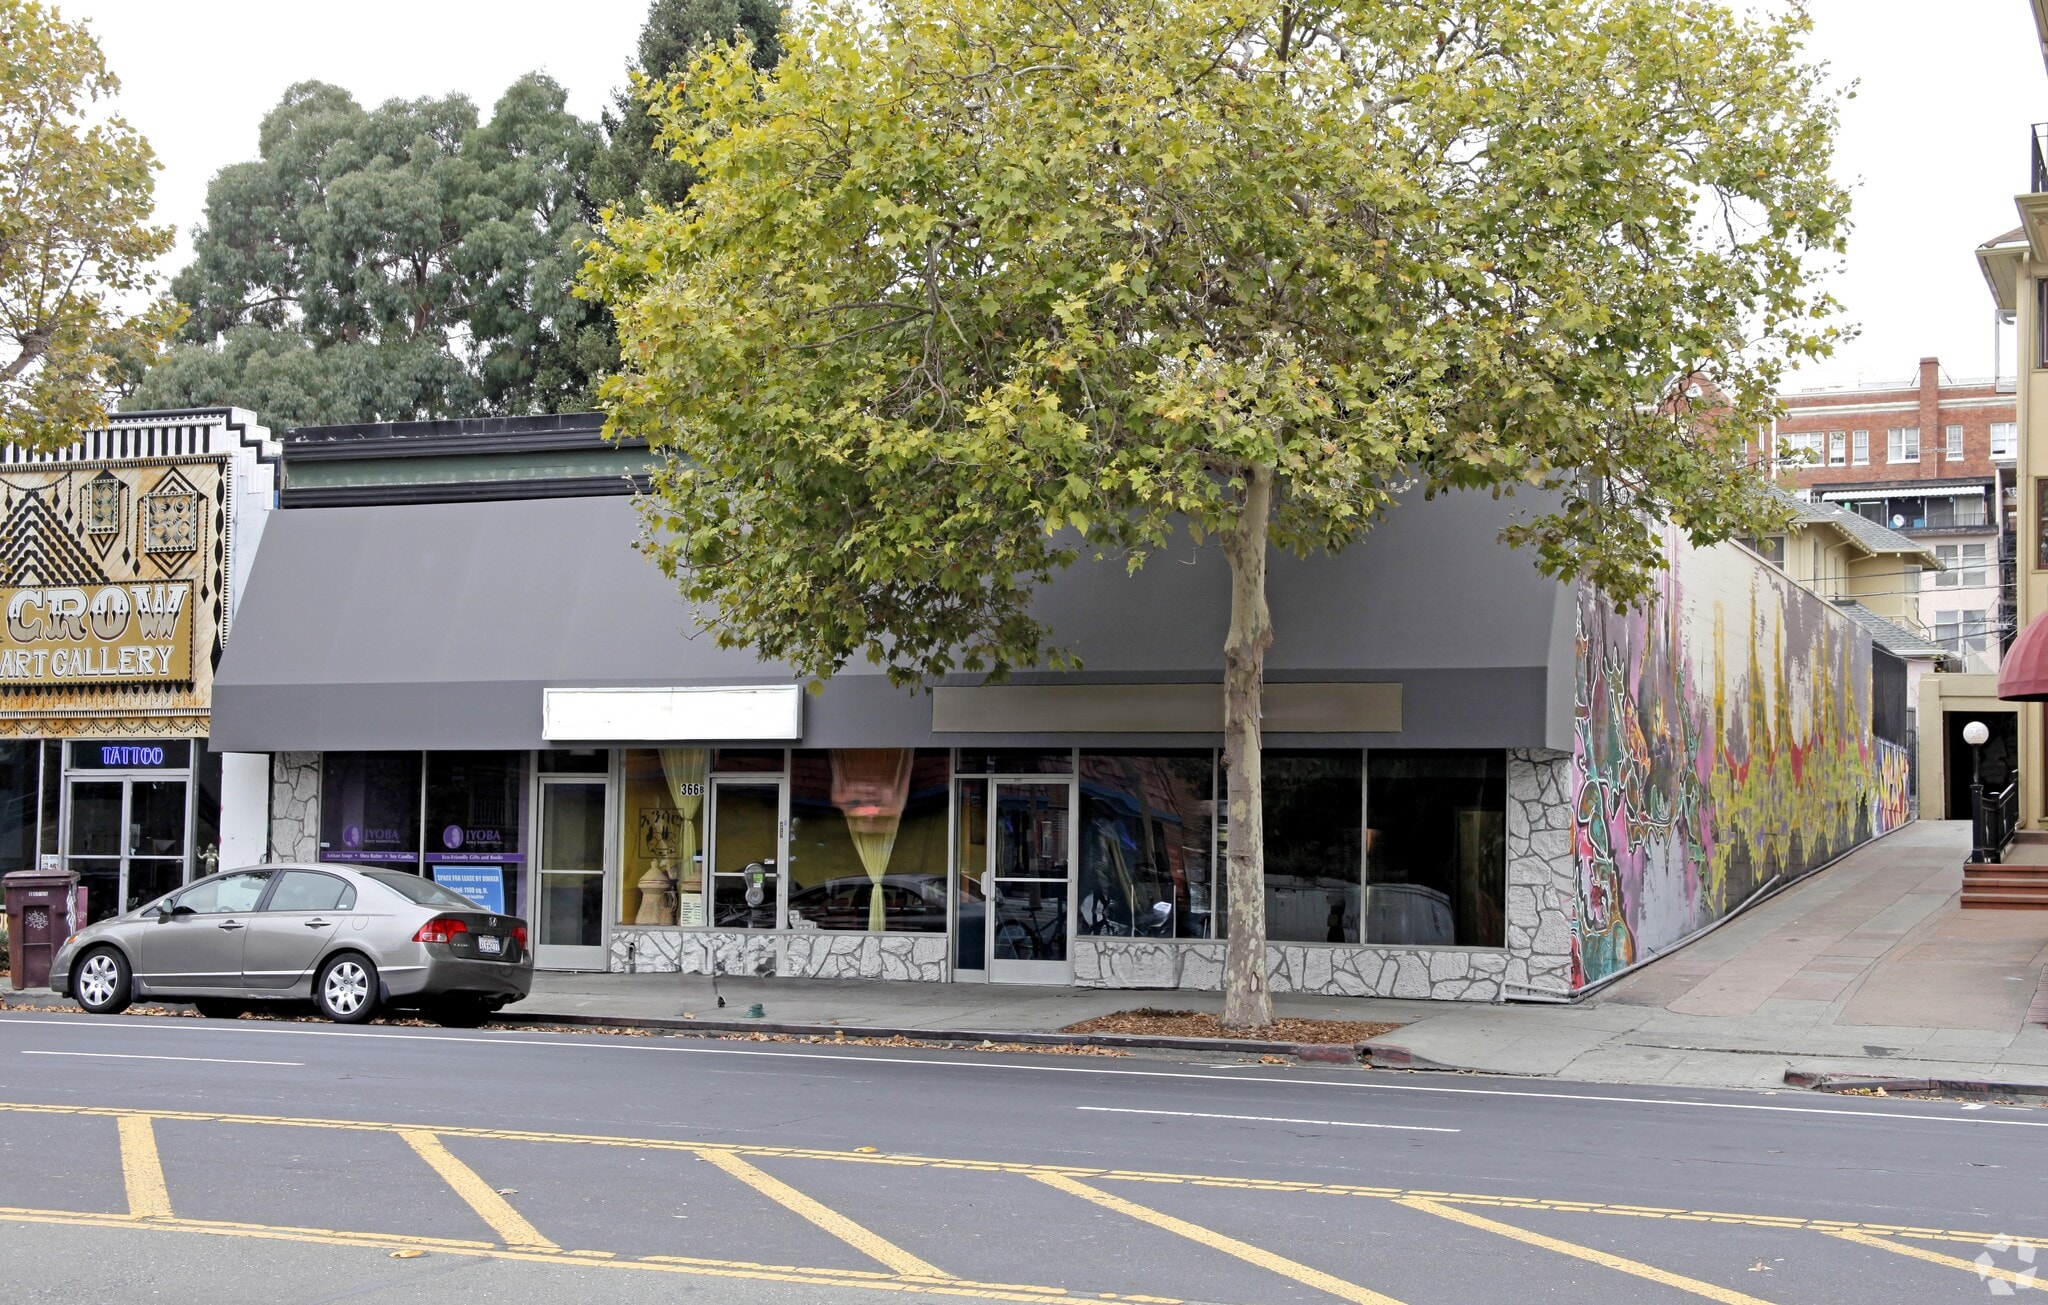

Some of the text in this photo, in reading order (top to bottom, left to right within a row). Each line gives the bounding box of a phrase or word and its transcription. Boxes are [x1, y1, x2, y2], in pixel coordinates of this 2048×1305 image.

[7, 584, 187, 643] CROW
[0, 645, 175, 679] ART GALLERY
[101, 746, 164, 765] TATTOO
[365, 829, 400, 840] IYOBA
[466, 829, 501, 841] IYOBA
